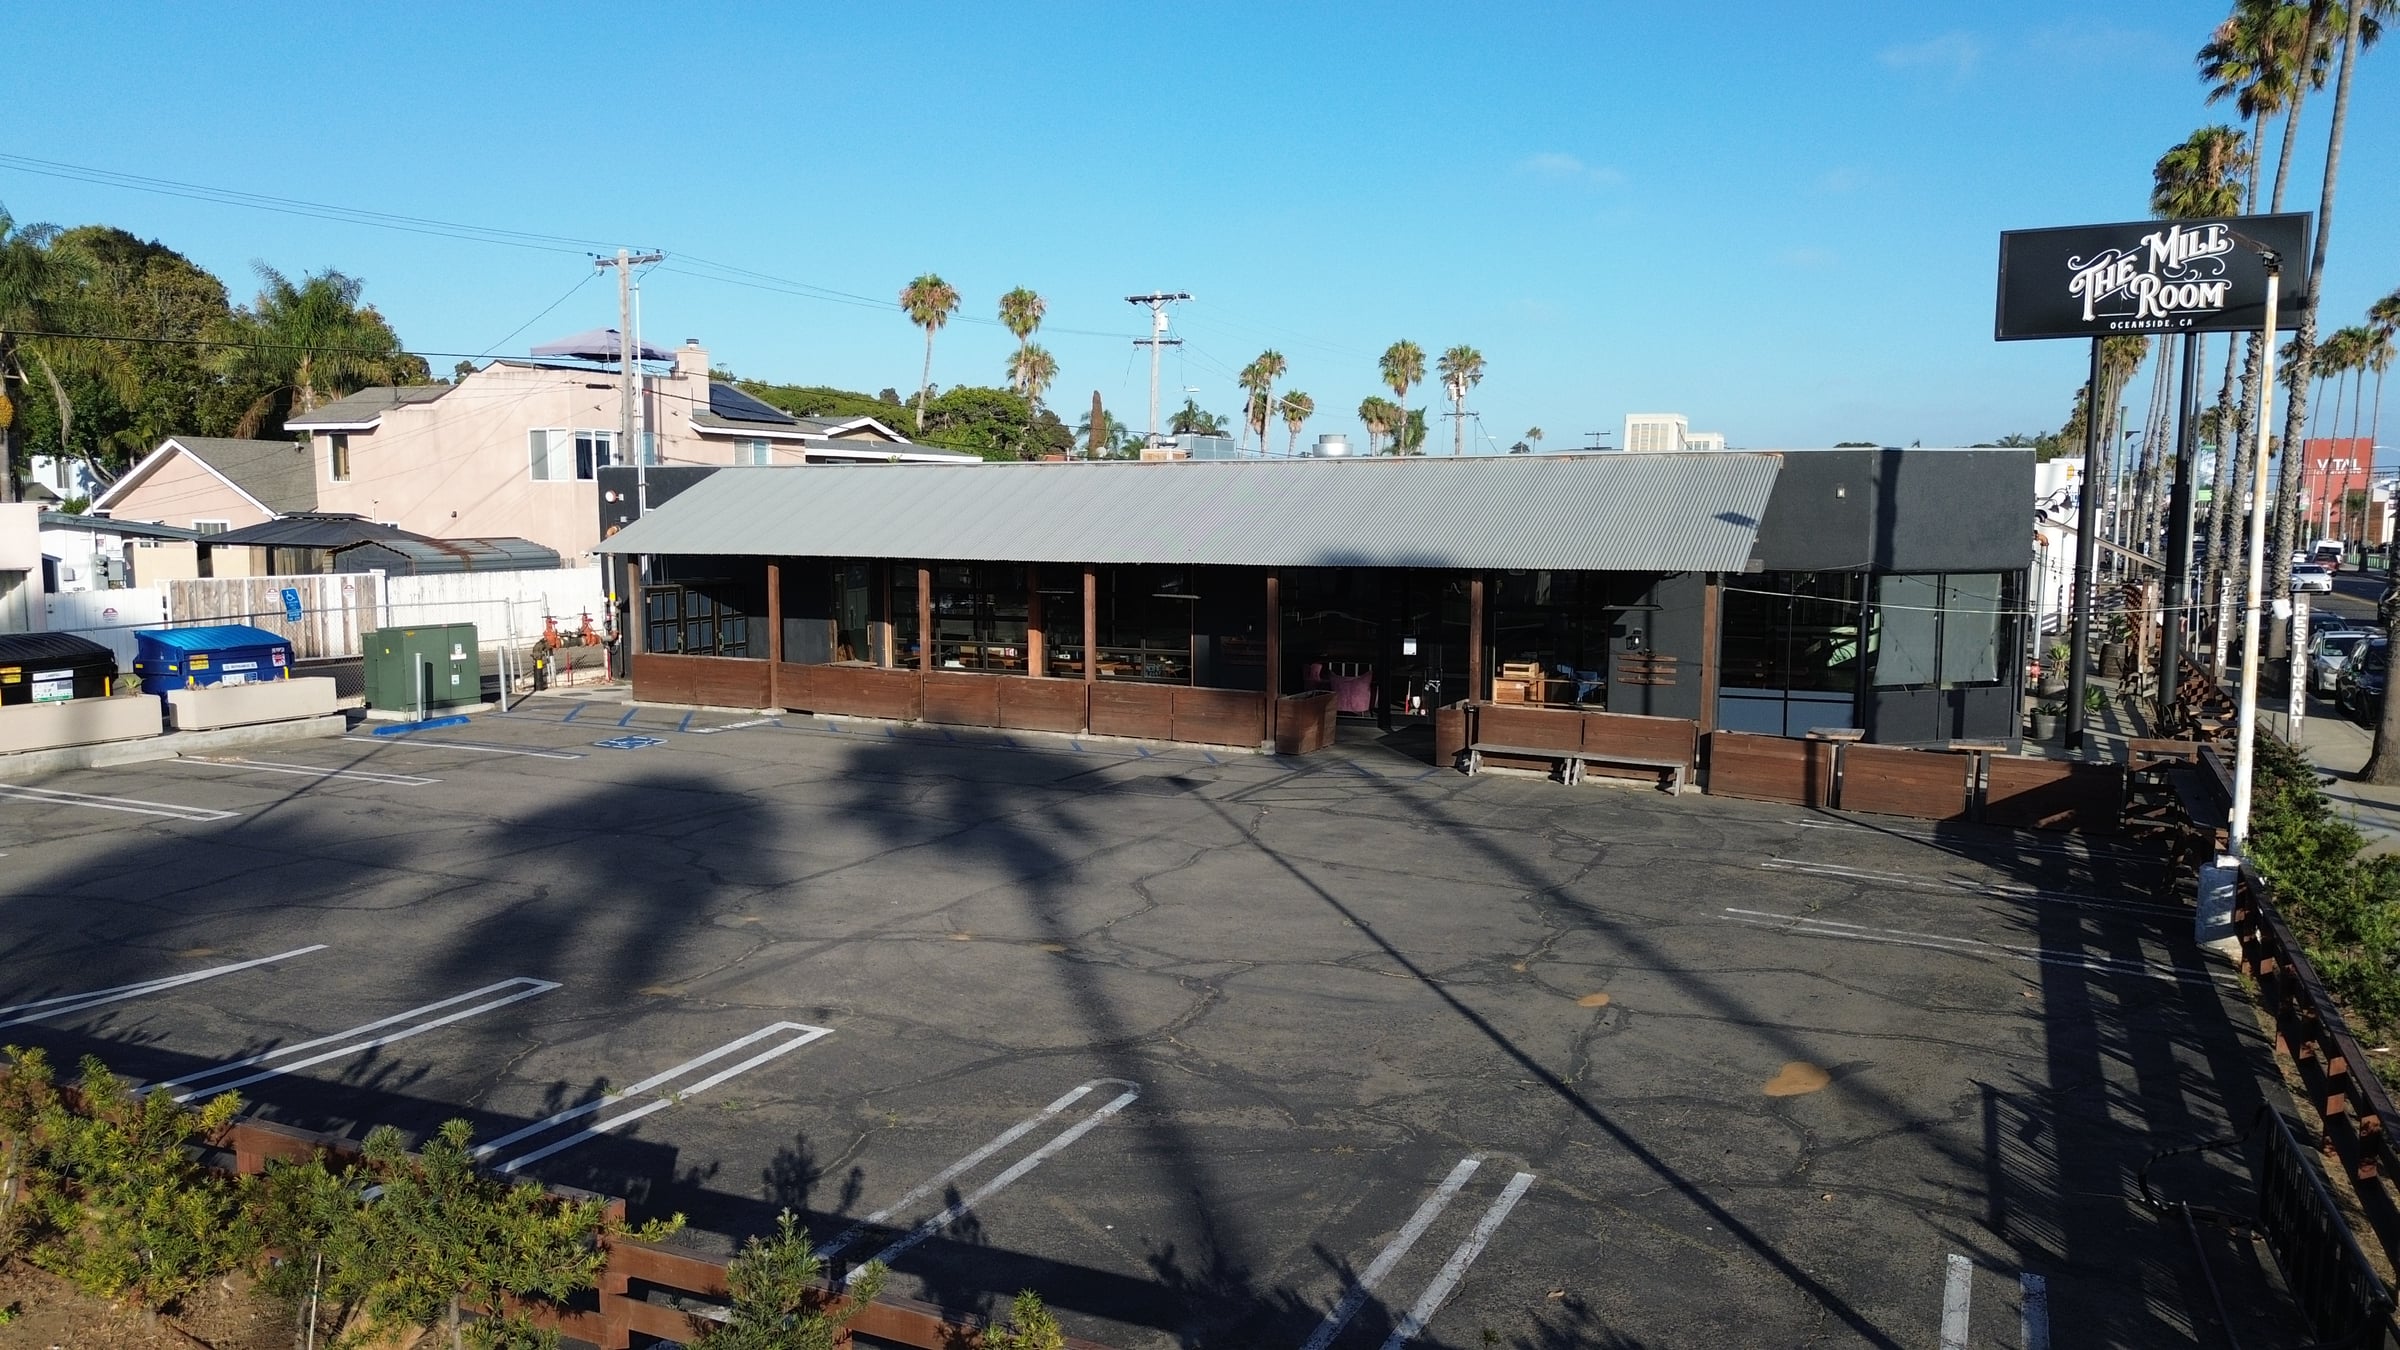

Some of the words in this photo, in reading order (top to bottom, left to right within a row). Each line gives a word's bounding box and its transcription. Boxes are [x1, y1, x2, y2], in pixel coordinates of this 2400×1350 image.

[2069, 254, 2138, 321] THE
[2141, 224, 2228, 274] MILL
[2130, 273, 2225, 318] ROOM
[2179, 318, 2193, 327] CA
[2316, 458, 2362, 471] VTAL
[2217, 577, 2232, 666] DISTILLERY
[2290, 603, 2308, 728] RESTAURANT
